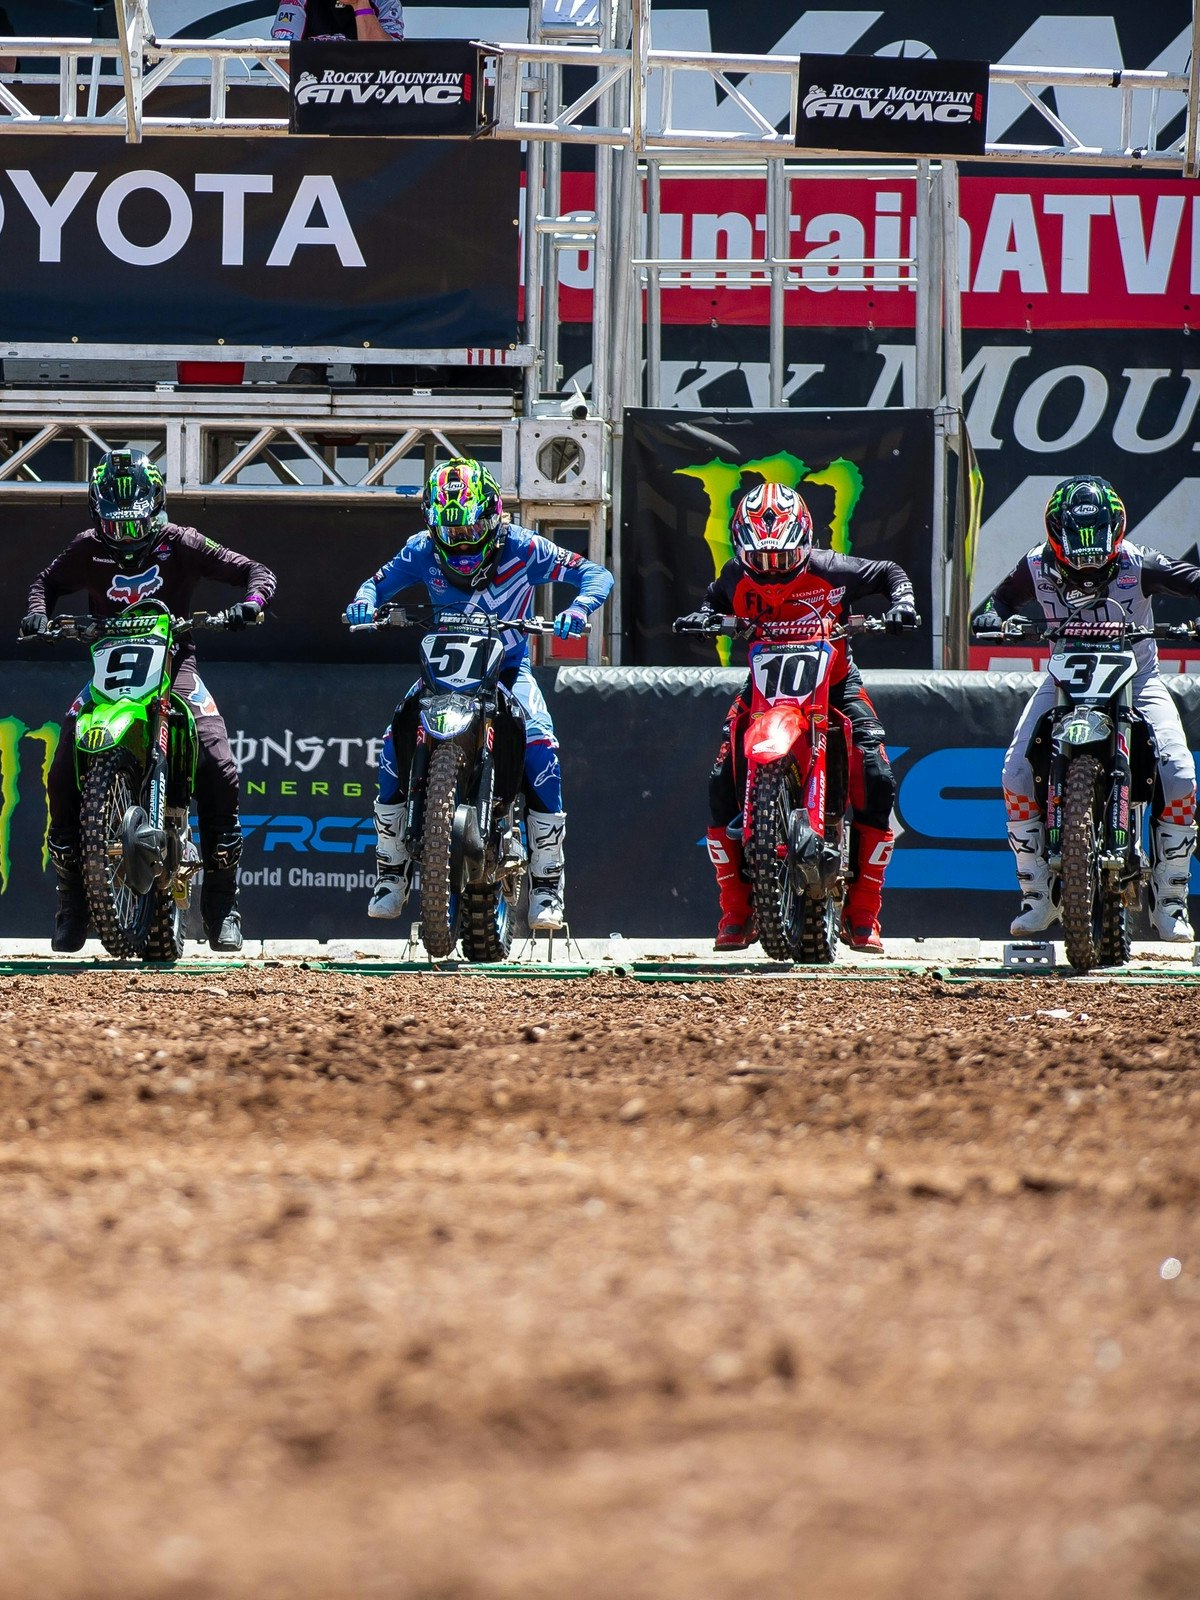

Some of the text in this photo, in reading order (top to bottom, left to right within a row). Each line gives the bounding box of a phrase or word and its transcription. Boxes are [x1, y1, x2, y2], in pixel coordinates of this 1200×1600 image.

[278, 11, 296, 22] CAT
[321, 69, 464, 85] ROCKY MOUNTAIN
[830, 84, 974, 104] ROCKY MOUNTAIN
[792, 588, 826, 598] HONDA
[429, 635, 498, 678] 51
[104, 645, 154, 690] 9
[761, 655, 819, 698] 10
[1060, 654, 1133, 695] 37
[228, 729, 385, 773] ONSTE
[247, 781, 380, 797] NERG
[235, 868, 281, 887] orld
